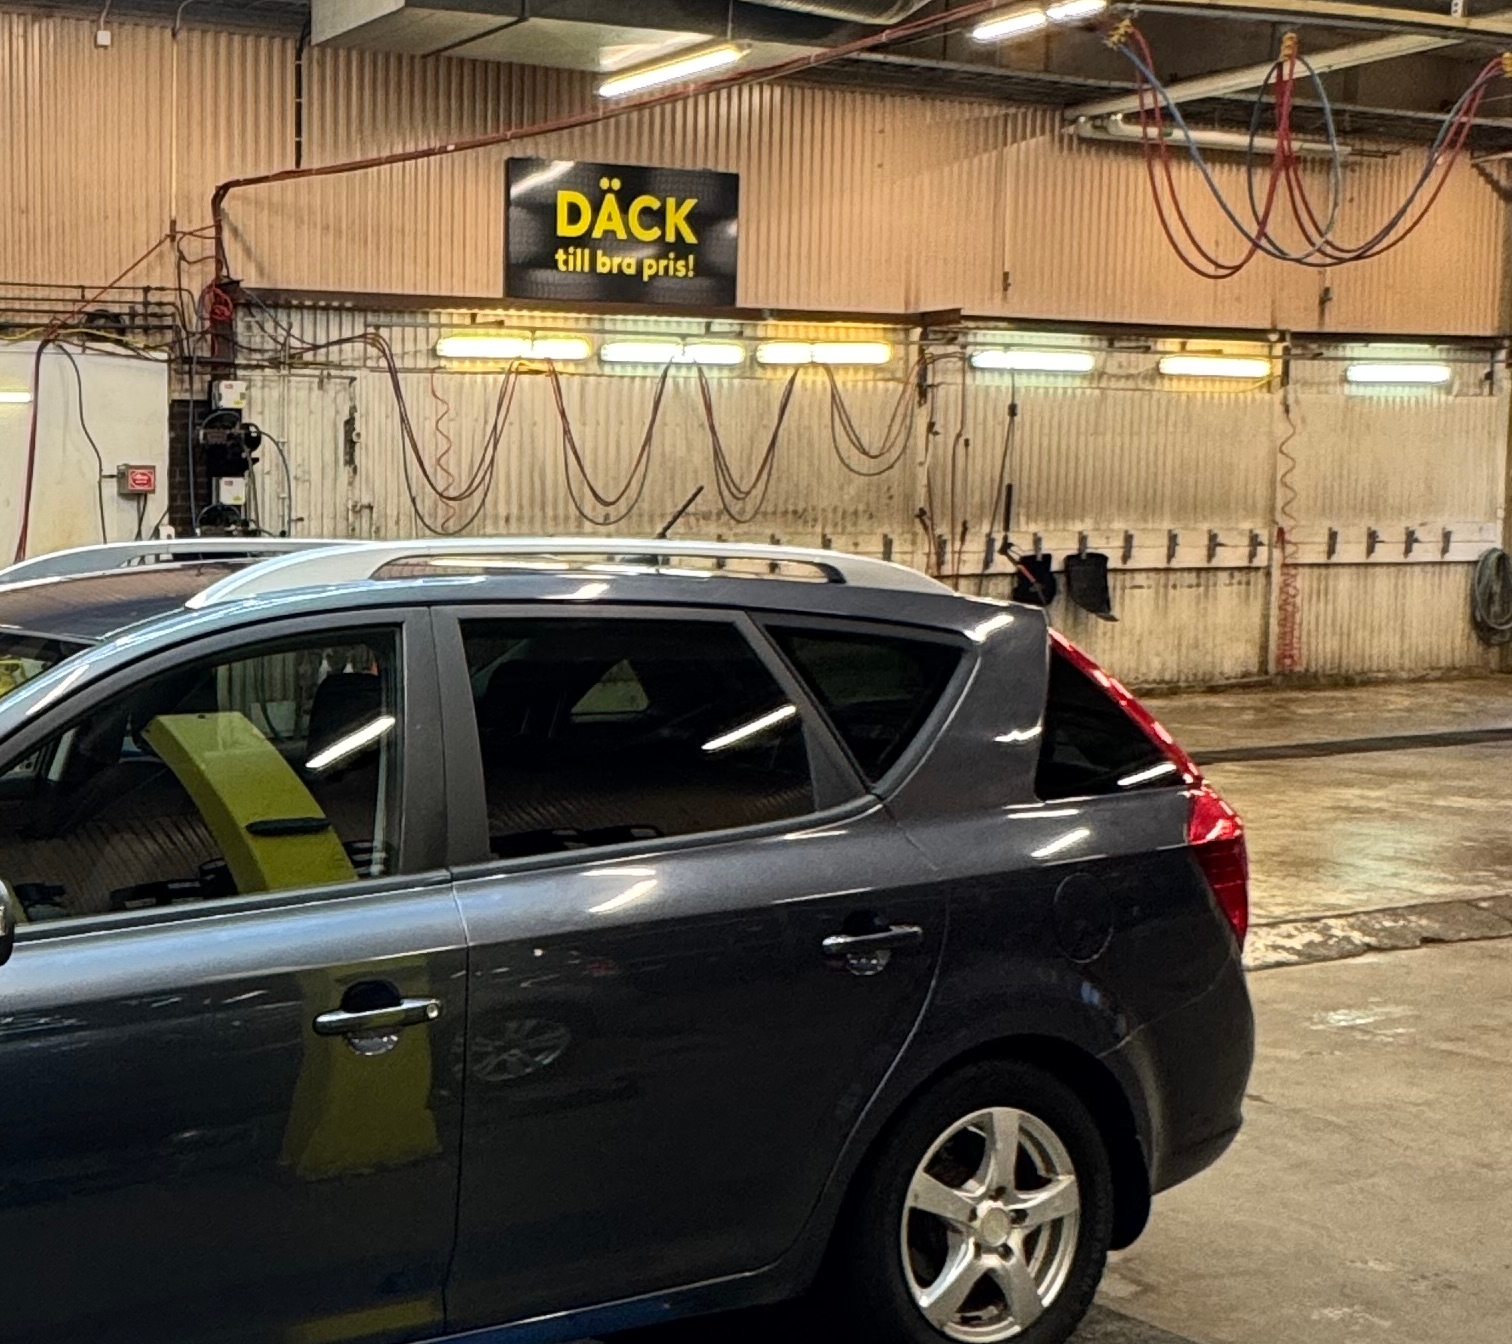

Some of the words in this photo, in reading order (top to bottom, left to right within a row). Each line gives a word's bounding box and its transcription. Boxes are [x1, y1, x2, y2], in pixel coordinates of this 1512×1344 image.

[555, 176, 699, 244] DÄCK
[554, 246, 590, 273] till
[596, 250, 637, 275] bra
[642, 253, 696, 282] pris!
